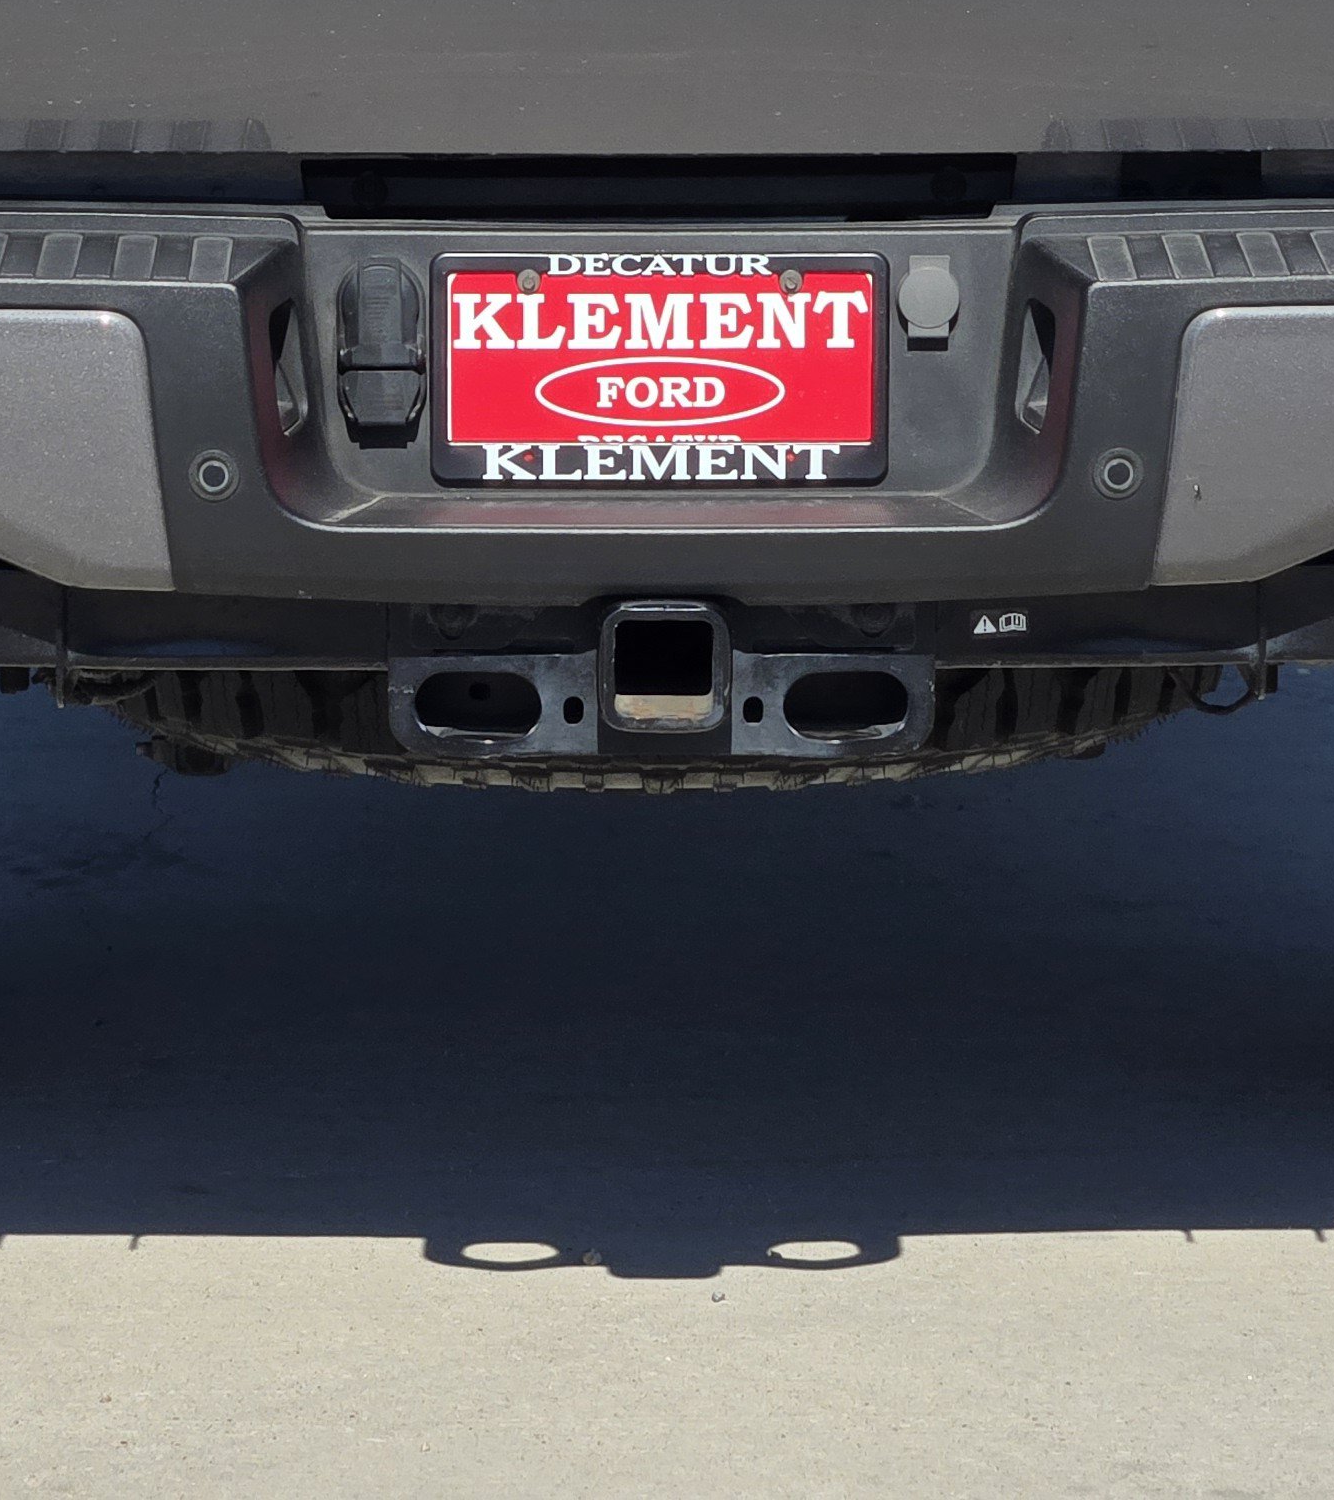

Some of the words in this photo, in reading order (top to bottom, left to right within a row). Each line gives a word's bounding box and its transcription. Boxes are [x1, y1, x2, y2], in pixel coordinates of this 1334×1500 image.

[547, 253, 772, 277] DECATUR
[452, 290, 869, 350] KLEMENT
[595, 375, 726, 409] FORD
[481, 443, 842, 481] KLEMENT
